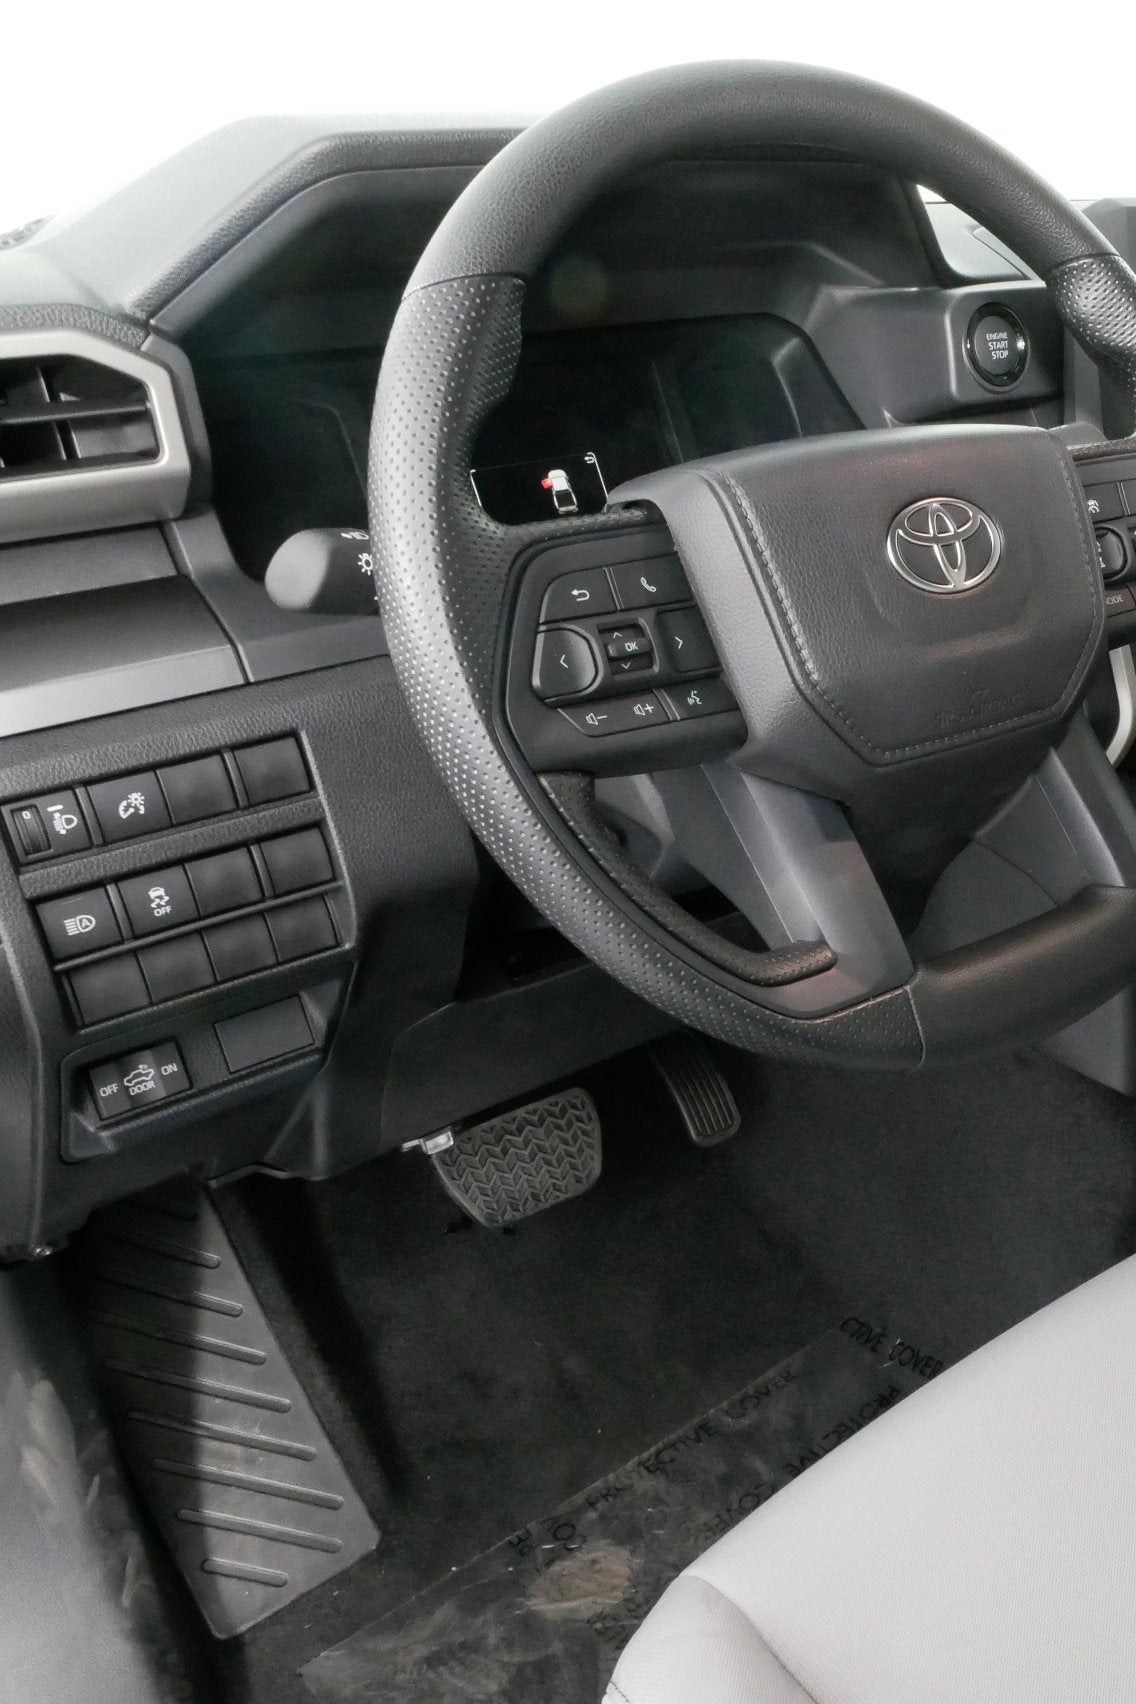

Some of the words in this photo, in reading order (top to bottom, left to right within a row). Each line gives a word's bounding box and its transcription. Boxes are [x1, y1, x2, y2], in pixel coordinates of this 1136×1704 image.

[986, 331, 1009, 341] ENGINE
[988, 340, 1010, 350] START
[991, 350, 1010, 360] STOP
[624, 641, 639, 652] OK
[153, 905, 172, 917] OFF
[100, 1083, 119, 1097] OFF
[160, 1062, 178, 1077] ON
[128, 1079, 156, 1097] DOOR
